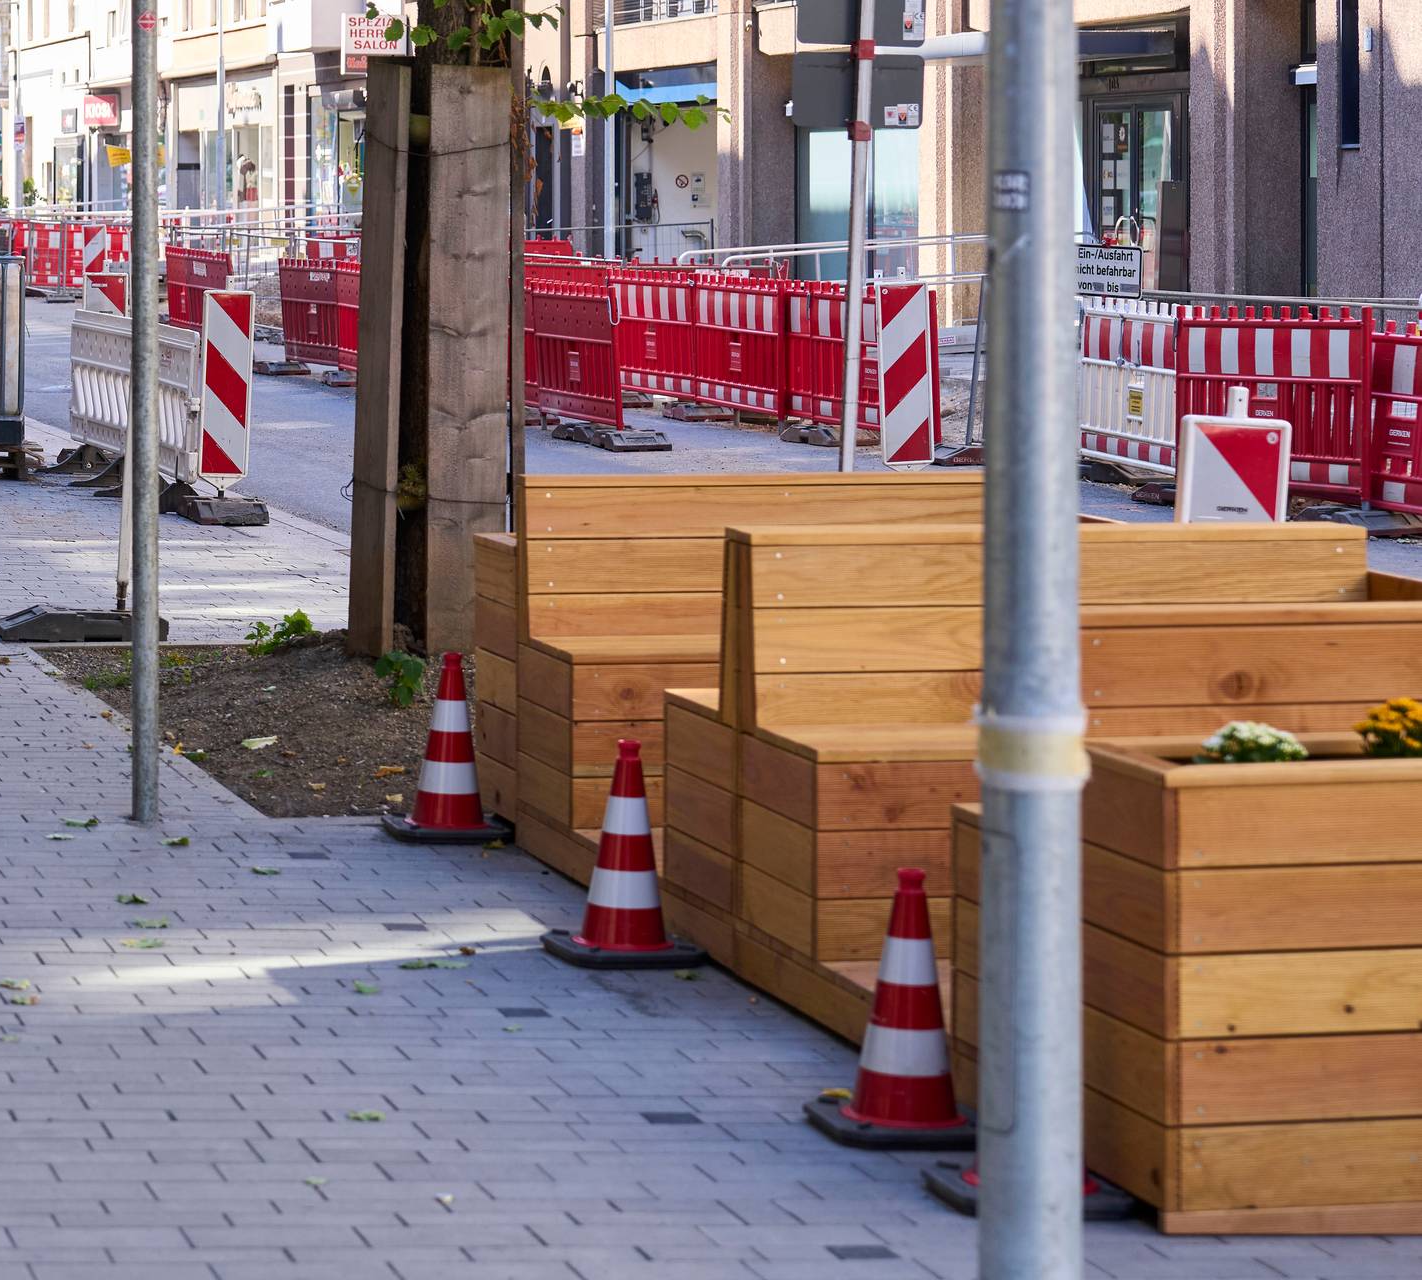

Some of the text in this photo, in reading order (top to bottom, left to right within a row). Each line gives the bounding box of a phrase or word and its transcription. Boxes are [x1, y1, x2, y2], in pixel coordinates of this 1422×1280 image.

[348, 16, 394, 27] SPEZIA
[350, 28, 384, 38] HERR
[354, 39, 397, 50] SALON
[85, 102, 115, 118] KIOSK
[1078, 247, 1134, 261] Ein-/Ausfahrt
[1096, 265, 1137, 277] befahrbar
[1077, 281, 1119, 293] von bis
